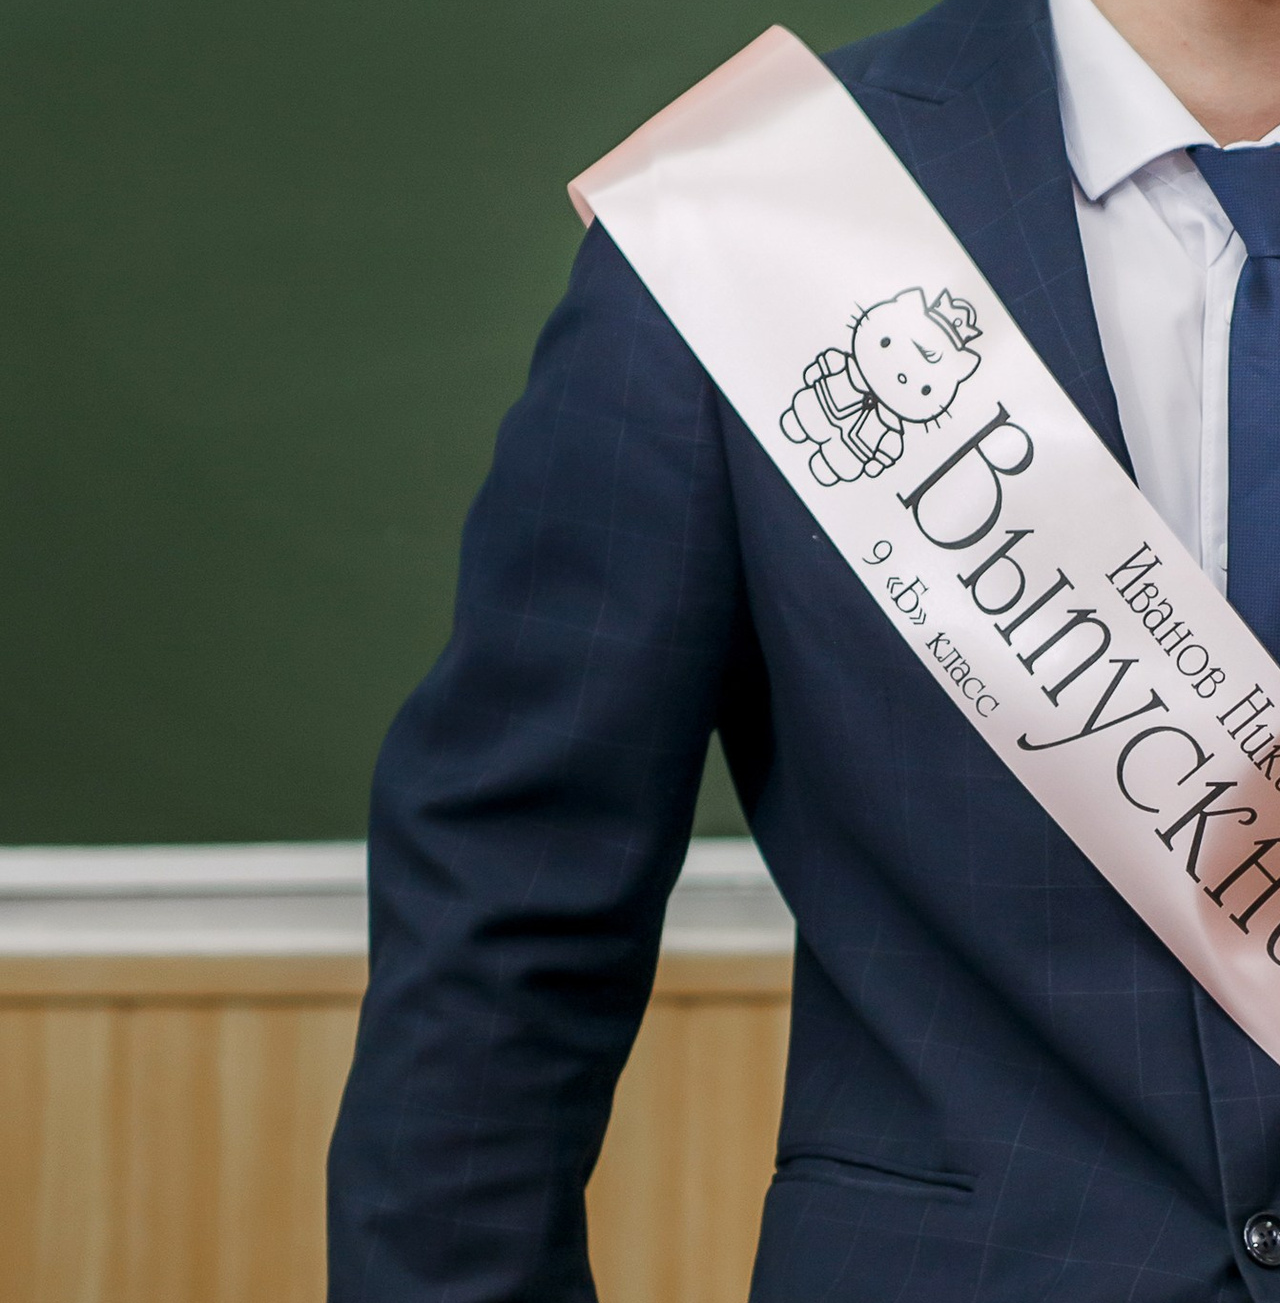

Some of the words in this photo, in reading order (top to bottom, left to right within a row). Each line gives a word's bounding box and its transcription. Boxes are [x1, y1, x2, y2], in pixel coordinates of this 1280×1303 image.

[862, 540, 893, 565] 9
[886, 576, 928, 627] «Б»
[926, 632, 1000, 718] класс
[1105, 541, 1227, 699] Иванов
